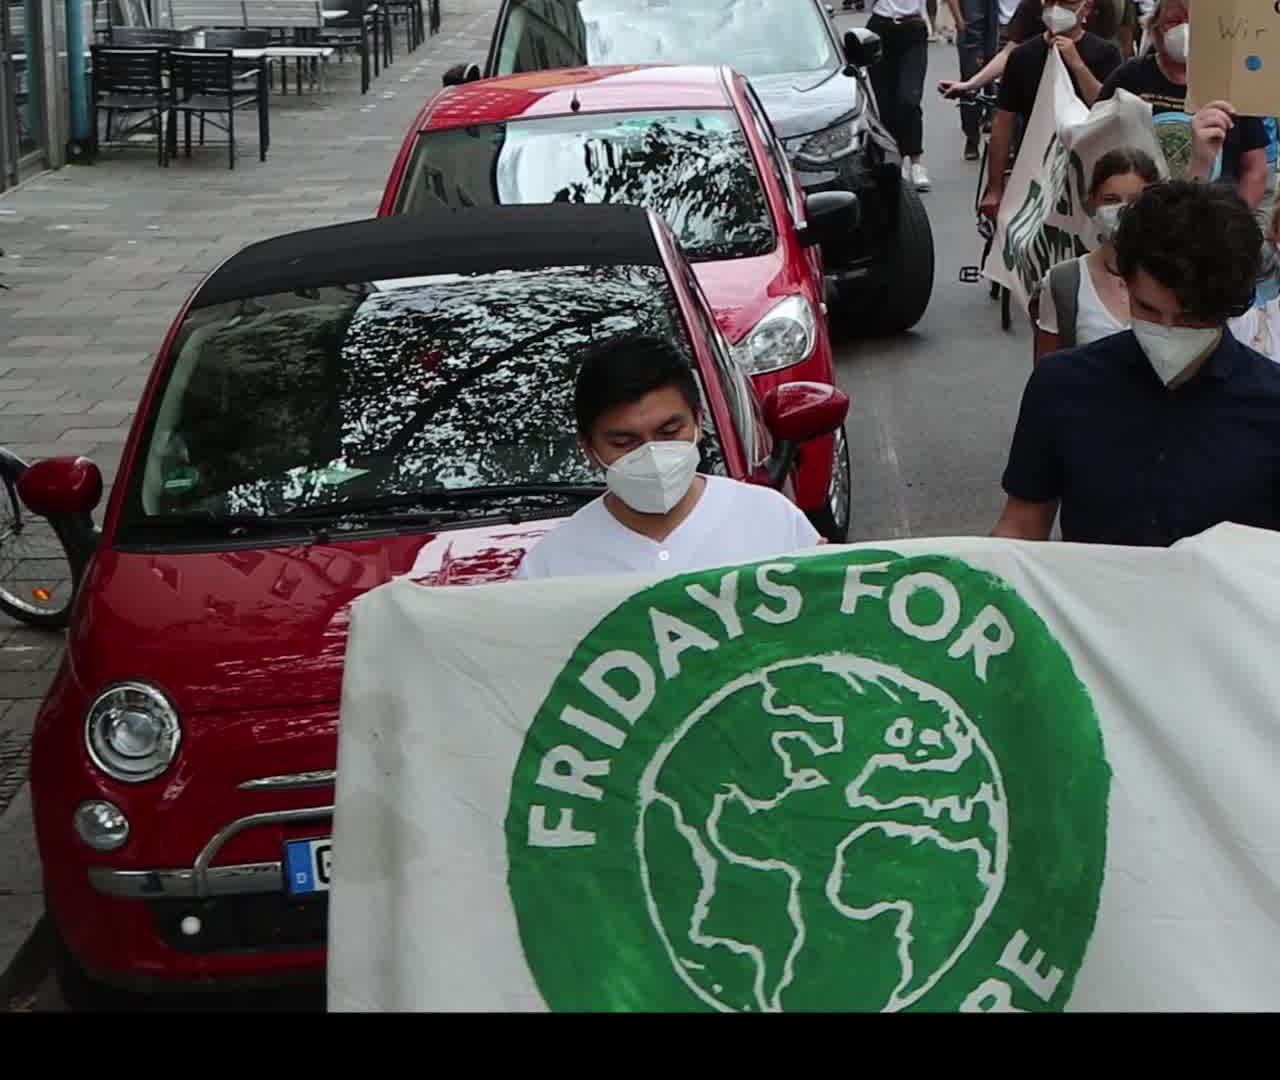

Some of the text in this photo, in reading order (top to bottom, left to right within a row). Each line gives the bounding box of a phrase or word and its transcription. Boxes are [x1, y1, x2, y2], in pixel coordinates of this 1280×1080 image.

[1218, 16, 1266, 40] Wir
[527, 562, 1018, 850] FRIDAYS FOR
